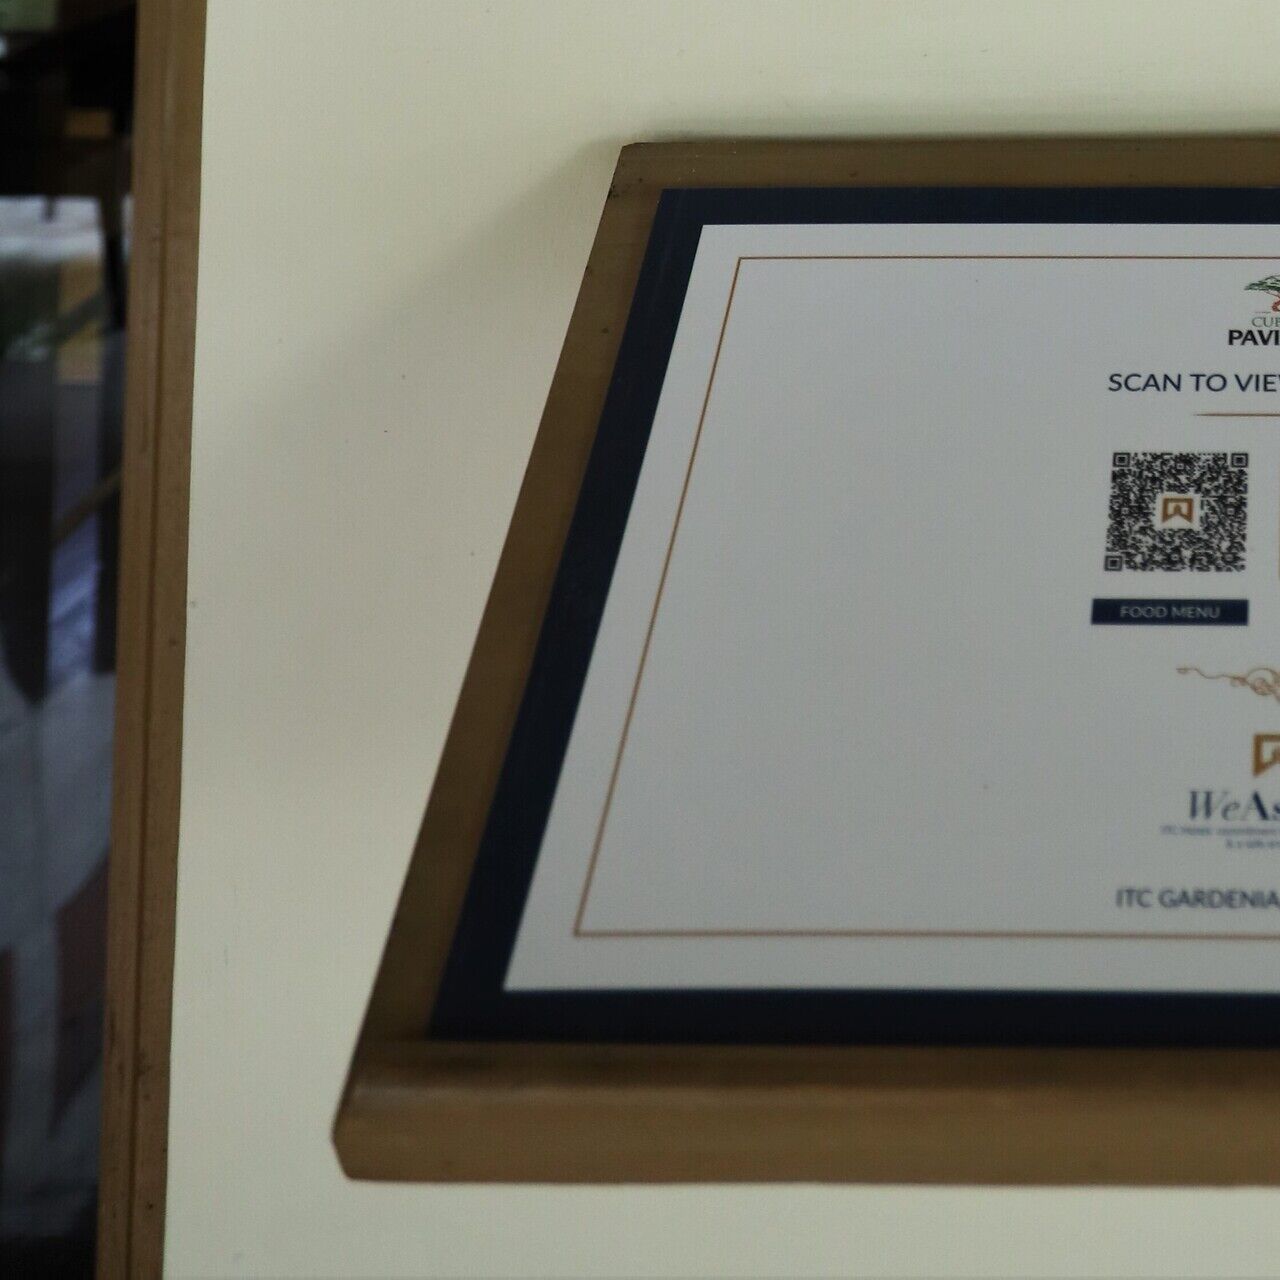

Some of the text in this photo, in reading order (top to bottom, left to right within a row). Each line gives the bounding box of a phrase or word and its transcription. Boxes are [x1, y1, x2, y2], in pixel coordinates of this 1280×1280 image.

[1108, 372, 1182, 392] SCAN
[1189, 373, 1228, 392] TO
[1120, 605, 1221, 619] FOOD MENU
[1115, 887, 1153, 909] ITC
